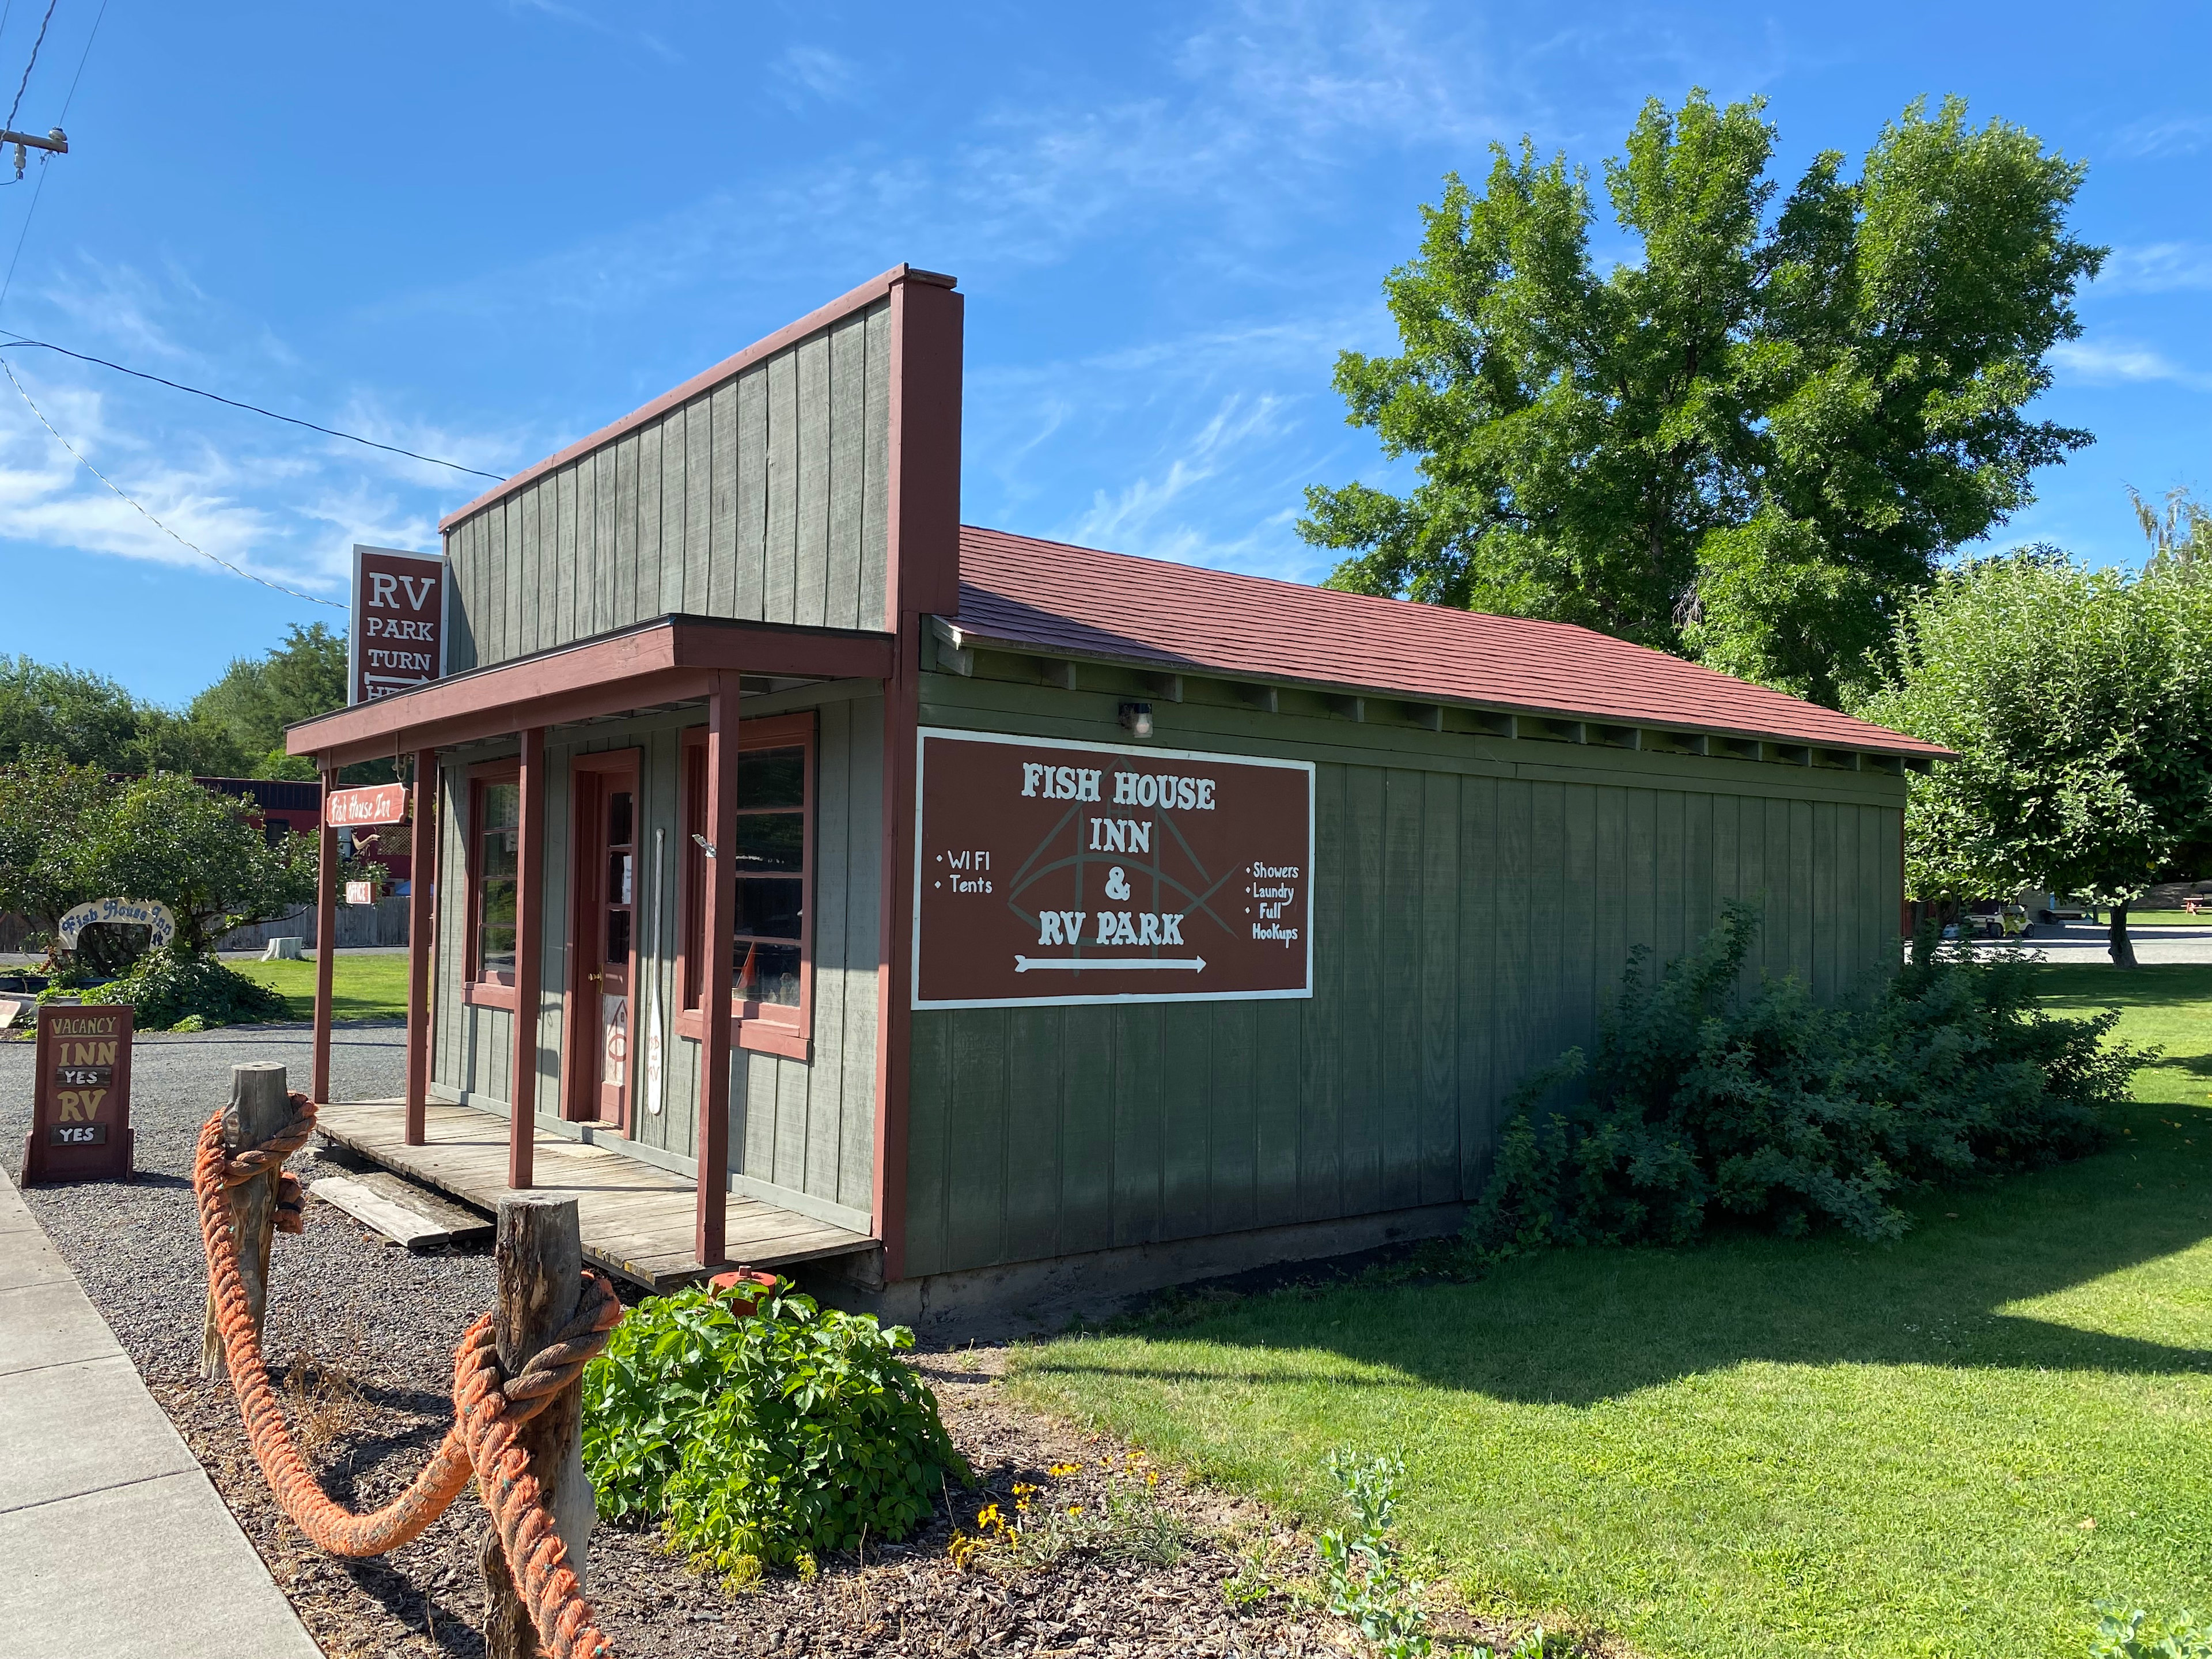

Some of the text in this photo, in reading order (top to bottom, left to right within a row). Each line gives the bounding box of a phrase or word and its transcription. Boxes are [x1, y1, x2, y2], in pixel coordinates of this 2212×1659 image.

[369, 572, 435, 611] RV
[367, 617, 434, 642] PARK
[368, 649, 432, 671] TURN
[1021, 762, 1215, 810] FISH HOUSE
[332, 792, 391, 823] Fish House Inn
[1089, 817, 1152, 853] INN
[1253, 861, 1300, 878] Showers
[348, 883, 366, 902] OFFICE
[949, 874, 993, 893] Tents
[1105, 866, 1130, 901] &
[1253, 881, 1294, 906] Laundry
[62, 899, 172, 935] Fish House Inn
[1259, 902, 1281, 919] Full
[1038, 911, 1184, 946] RV PARK
[51, 1016, 116, 1035] VACANCY
[59, 1041, 118, 1067] INN
[65, 1070, 98, 1084] YES
[57, 1089, 107, 1122] RV
[59, 1127, 94, 1142] YES
